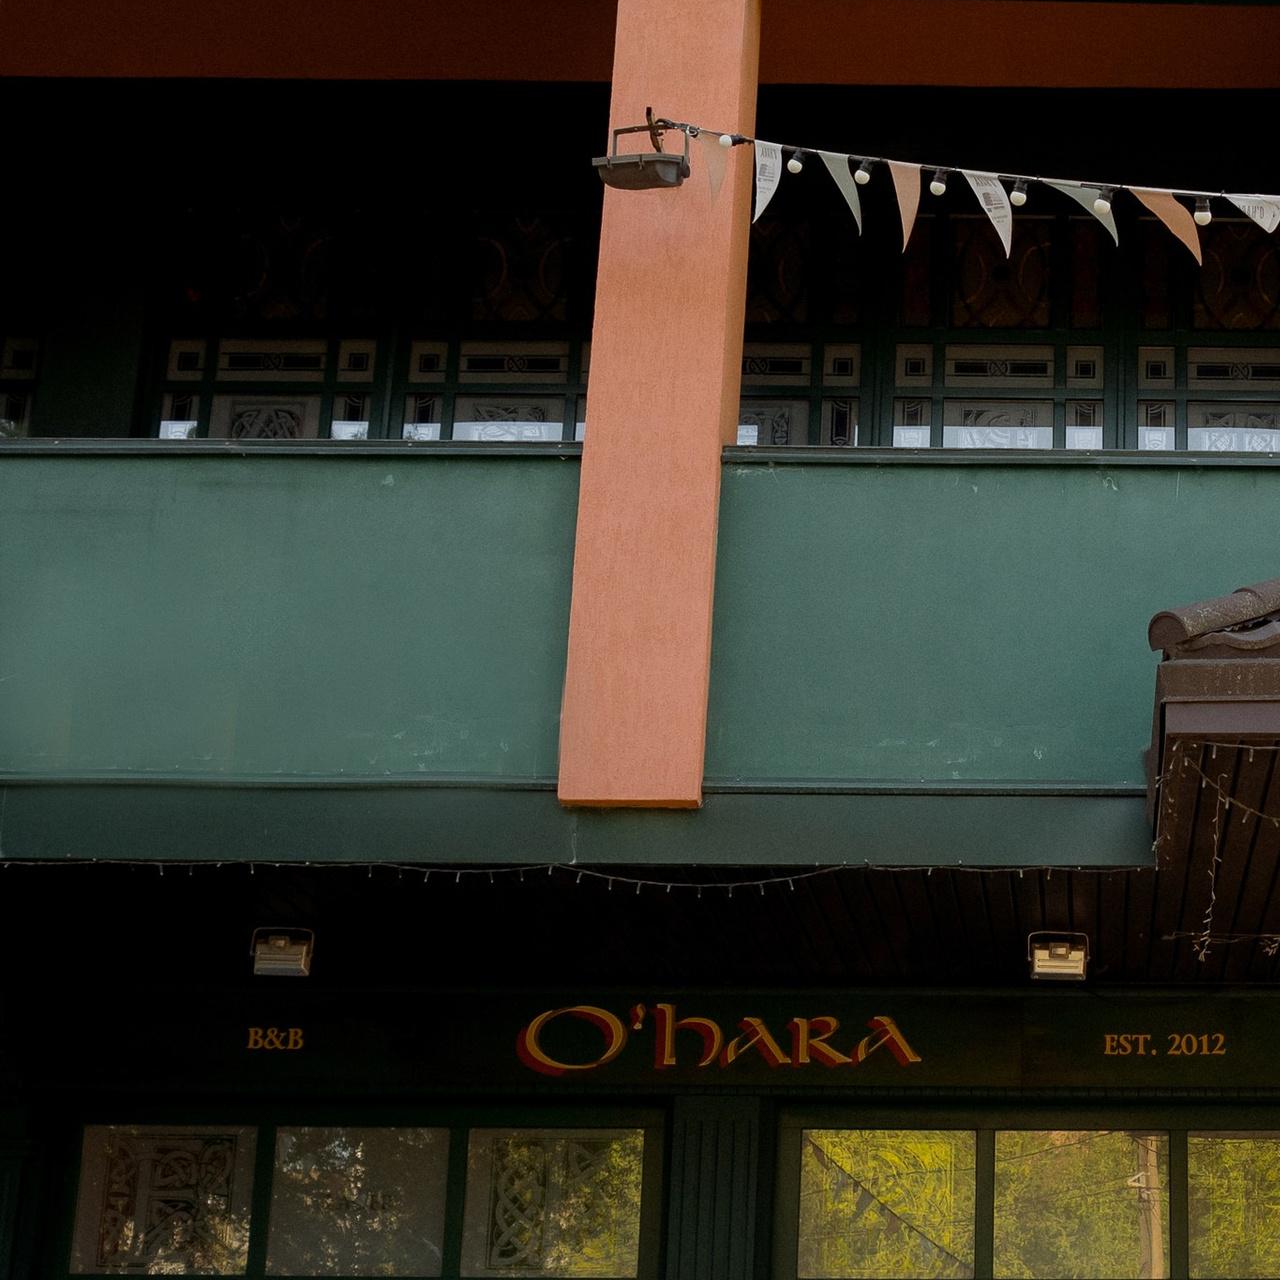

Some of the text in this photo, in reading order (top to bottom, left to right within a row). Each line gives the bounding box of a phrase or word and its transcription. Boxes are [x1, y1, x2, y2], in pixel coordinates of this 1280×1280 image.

[246, 1025, 304, 1050] B&B
[1103, 1032, 1227, 1056] EST. 2012
